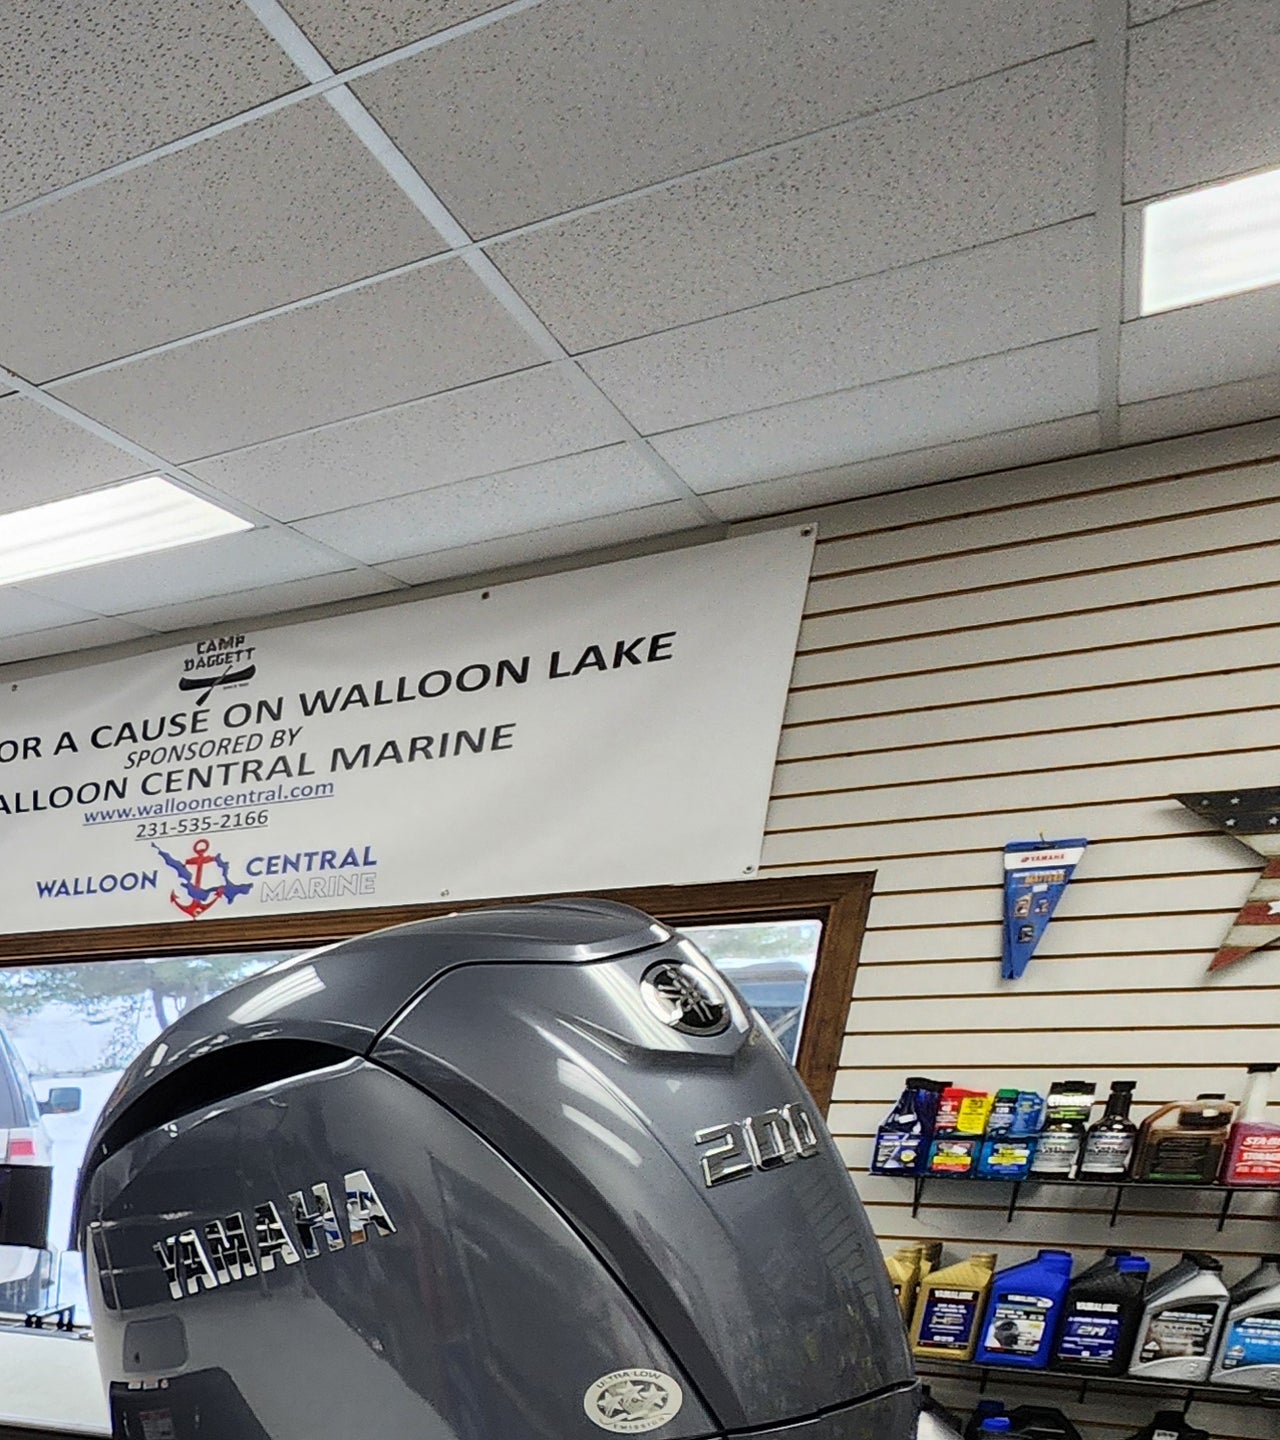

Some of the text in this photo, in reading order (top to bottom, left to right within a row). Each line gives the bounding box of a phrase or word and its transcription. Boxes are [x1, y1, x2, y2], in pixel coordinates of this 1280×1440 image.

[184, 647, 256, 672] DAGGETT
[197, 635, 245, 655] CAMP
[53, 731, 79, 756] A
[90, 708, 210, 750] CAUSE
[223, 696, 284, 728] ON
[299, 656, 530, 717] WALLOON
[548, 631, 678, 680] LAKE
[123, 726, 303, 770] SPONSORED BY
[140, 752, 316, 798] CENTRAL
[329, 723, 517, 773] MARINE
[83, 780, 335, 826] www.wallooncentral.com
[135, 809, 269, 840] 231-535-2166
[36, 846, 378, 899] WALLOON CENTRAL
[259, 872, 377, 903] MARINE
[153, 1169, 397, 1300] YAMAHA
[596, 1370, 662, 1389] ULTRA LOW
